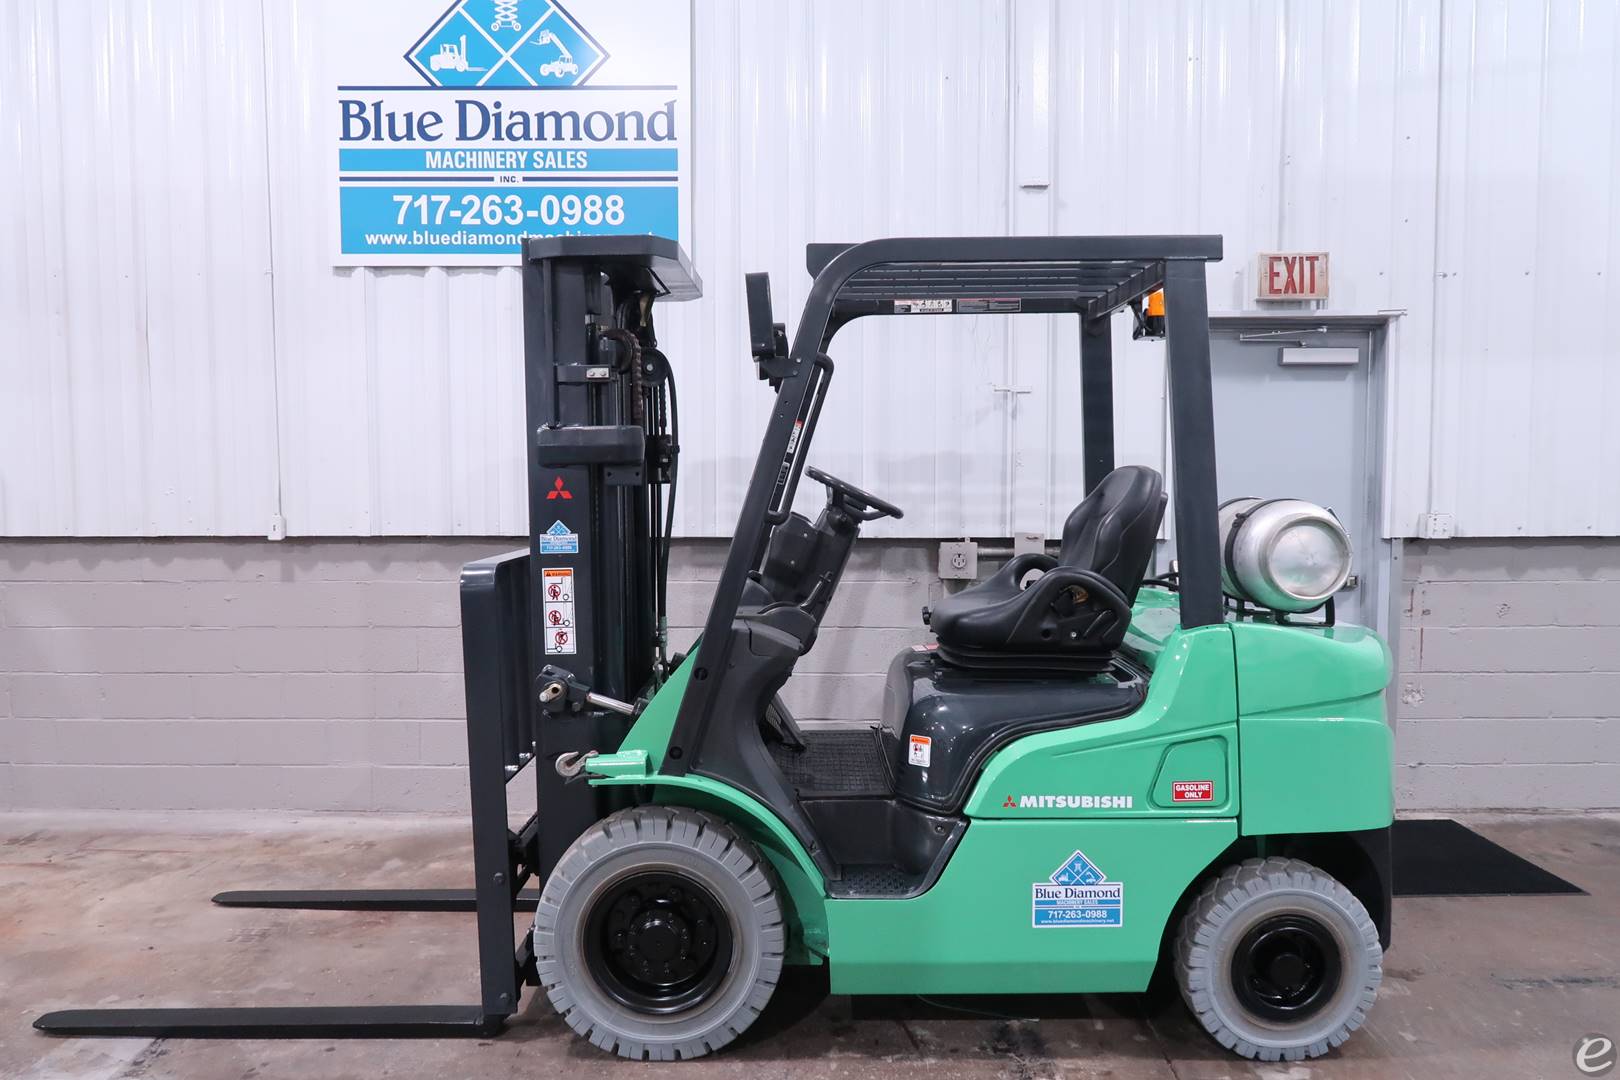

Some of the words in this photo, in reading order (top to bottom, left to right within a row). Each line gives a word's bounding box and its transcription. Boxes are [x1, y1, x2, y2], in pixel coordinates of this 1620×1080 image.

[339, 99, 443, 141] Blue
[455, 99, 677, 141] Diamond
[425, 151, 528, 169] MACHINERY
[533, 151, 588, 169] SALES
[500, 175, 519, 183] INC.
[392, 195, 625, 226] 717-263-0988
[365, 230, 653, 246] www.bluediamond
[1269, 256, 1319, 294] EXIT
[1020, 796, 1133, 809] MITSUBISHI
[1035, 887, 1061, 899] Blue
[1065, 887, 1120, 899] Diamond
[1048, 910, 1107, 919] 717-263-0988
